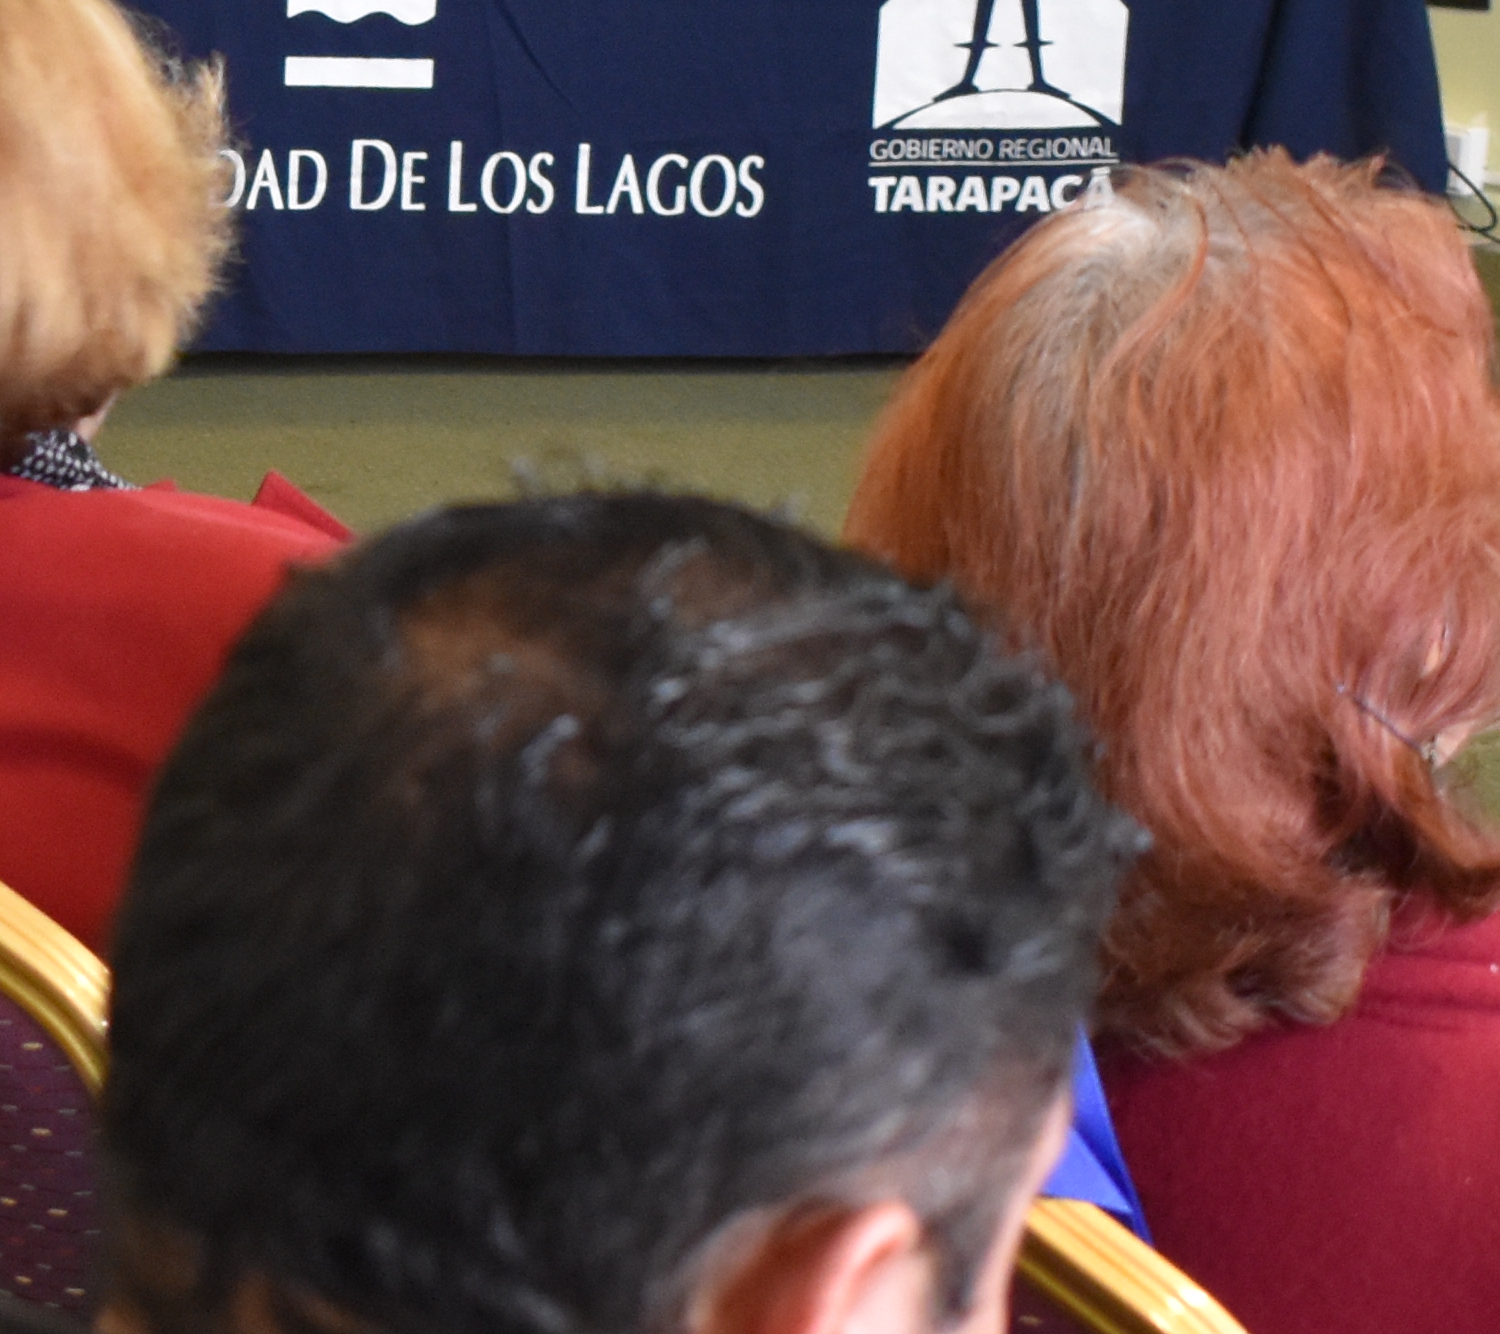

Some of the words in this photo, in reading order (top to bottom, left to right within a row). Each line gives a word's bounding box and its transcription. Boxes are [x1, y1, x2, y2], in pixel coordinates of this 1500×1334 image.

[869, 138, 994, 161] GOBIERNO
[999, 136, 1118, 159] REGIONAL
[448, 140, 555, 215] LOS
[576, 142, 766, 218] LAGOS
